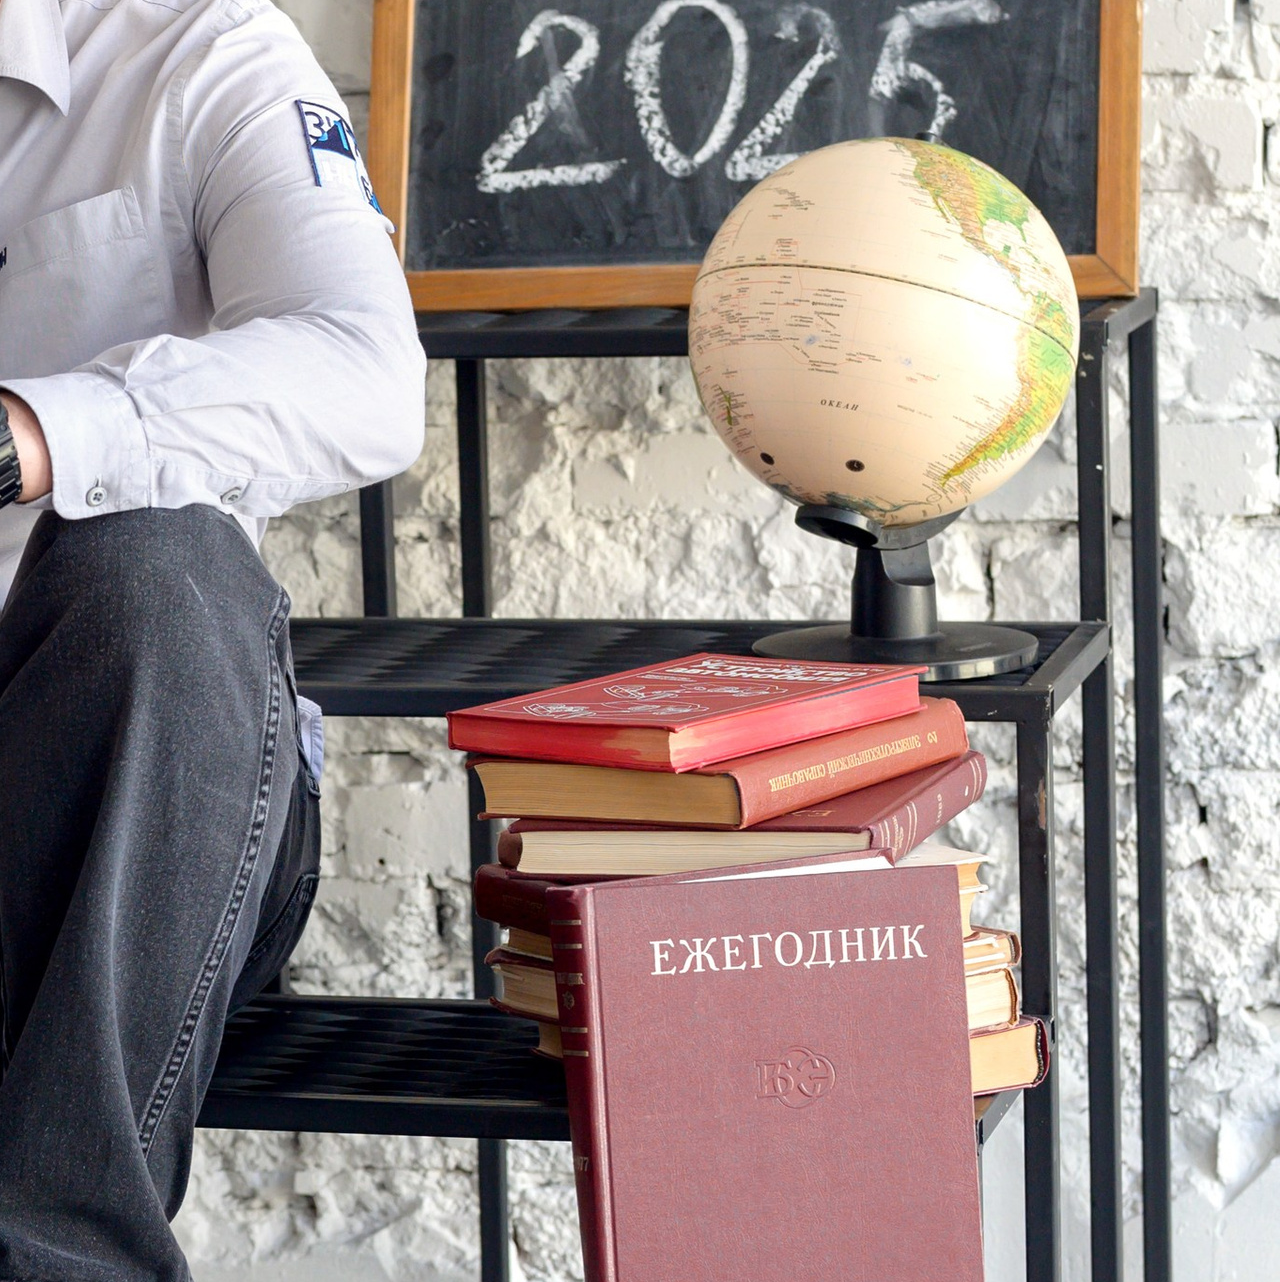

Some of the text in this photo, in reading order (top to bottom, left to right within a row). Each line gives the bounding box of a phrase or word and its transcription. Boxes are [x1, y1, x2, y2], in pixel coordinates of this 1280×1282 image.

[820, 399, 859, 411] ОКЕАН
[827, 734, 921, 778] ЭЛЕКТРОТЕХНИЧЕСКИЙ
[769, 763, 826, 792] СПРАВОЧНИК
[649, 924, 928, 976] ЕЖЕГОДНИК
